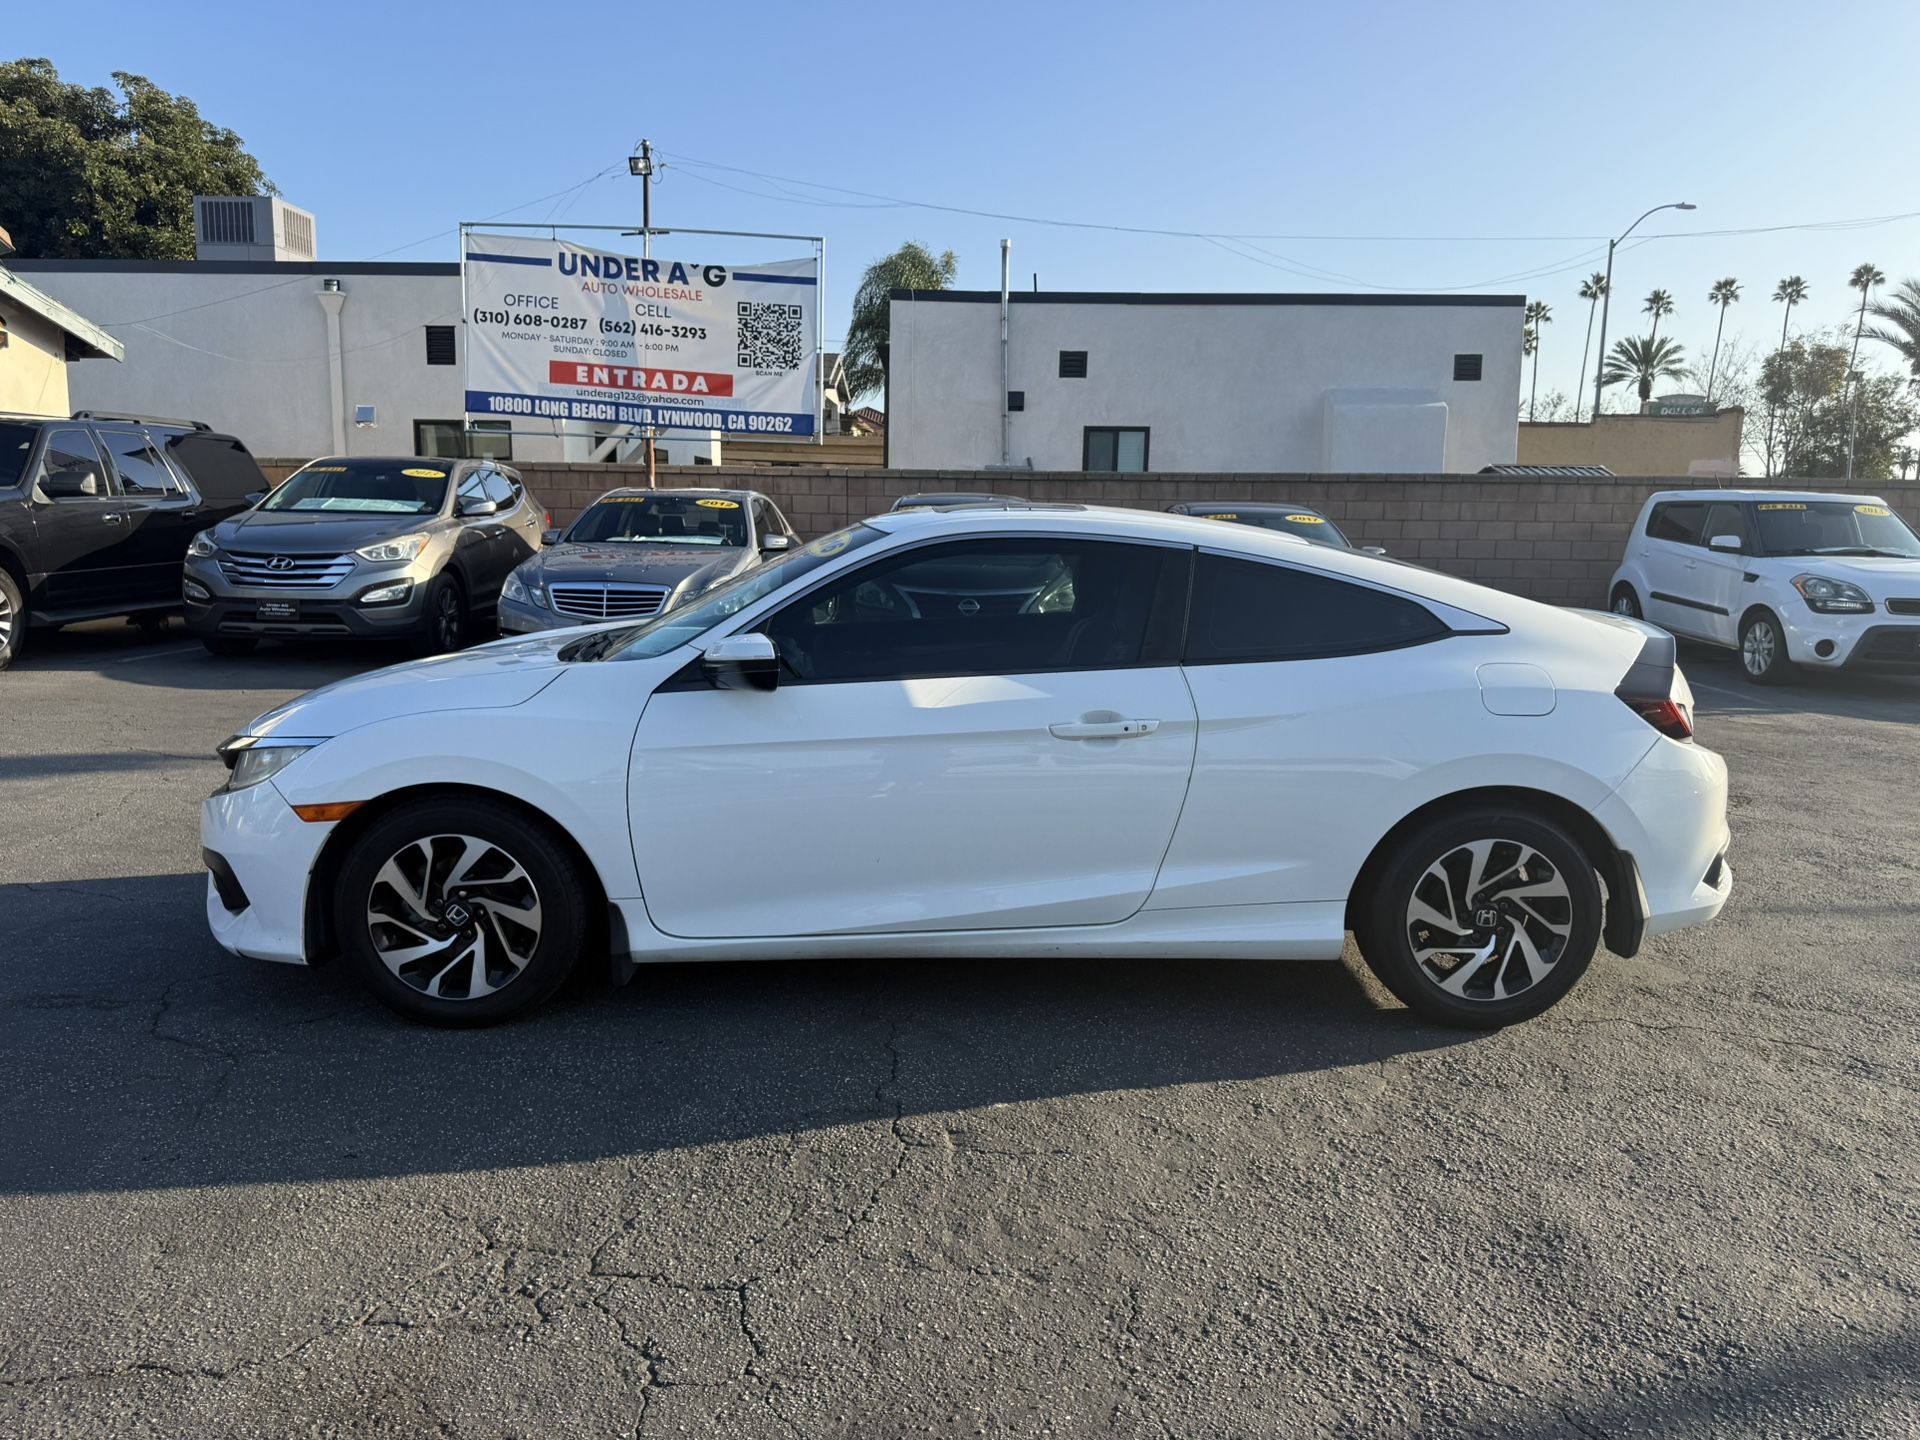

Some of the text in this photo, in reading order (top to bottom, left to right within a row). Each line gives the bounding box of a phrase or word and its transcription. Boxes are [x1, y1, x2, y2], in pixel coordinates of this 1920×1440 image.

[558, 252, 661, 284] UNDER
[503, 293, 560, 310] OFFICE
[581, 281, 703, 302] AUTO WHOLESALE
[473, 308, 587, 330] (310) 608-0287
[635, 303, 672, 319] CELL
[599, 317, 707, 340] (562) 416-3293
[501, 331, 542, 342] MONDAY
[549, 334, 594, 346] SATURDAY
[600, 339, 619, 348] 9:00
[620, 340, 635, 349] AM
[645, 343, 663, 352] 6:00
[666, 344, 679, 353] PM
[553, 344, 628, 359] SUNDAY: CLOSED
[576, 365, 709, 393] ENTRADA
[576, 387, 705, 407] underag123@yahoo.com
[488, 396, 793, 432] 10800 LONG BEACH BLVD. LYNWOOD, CA 90262
